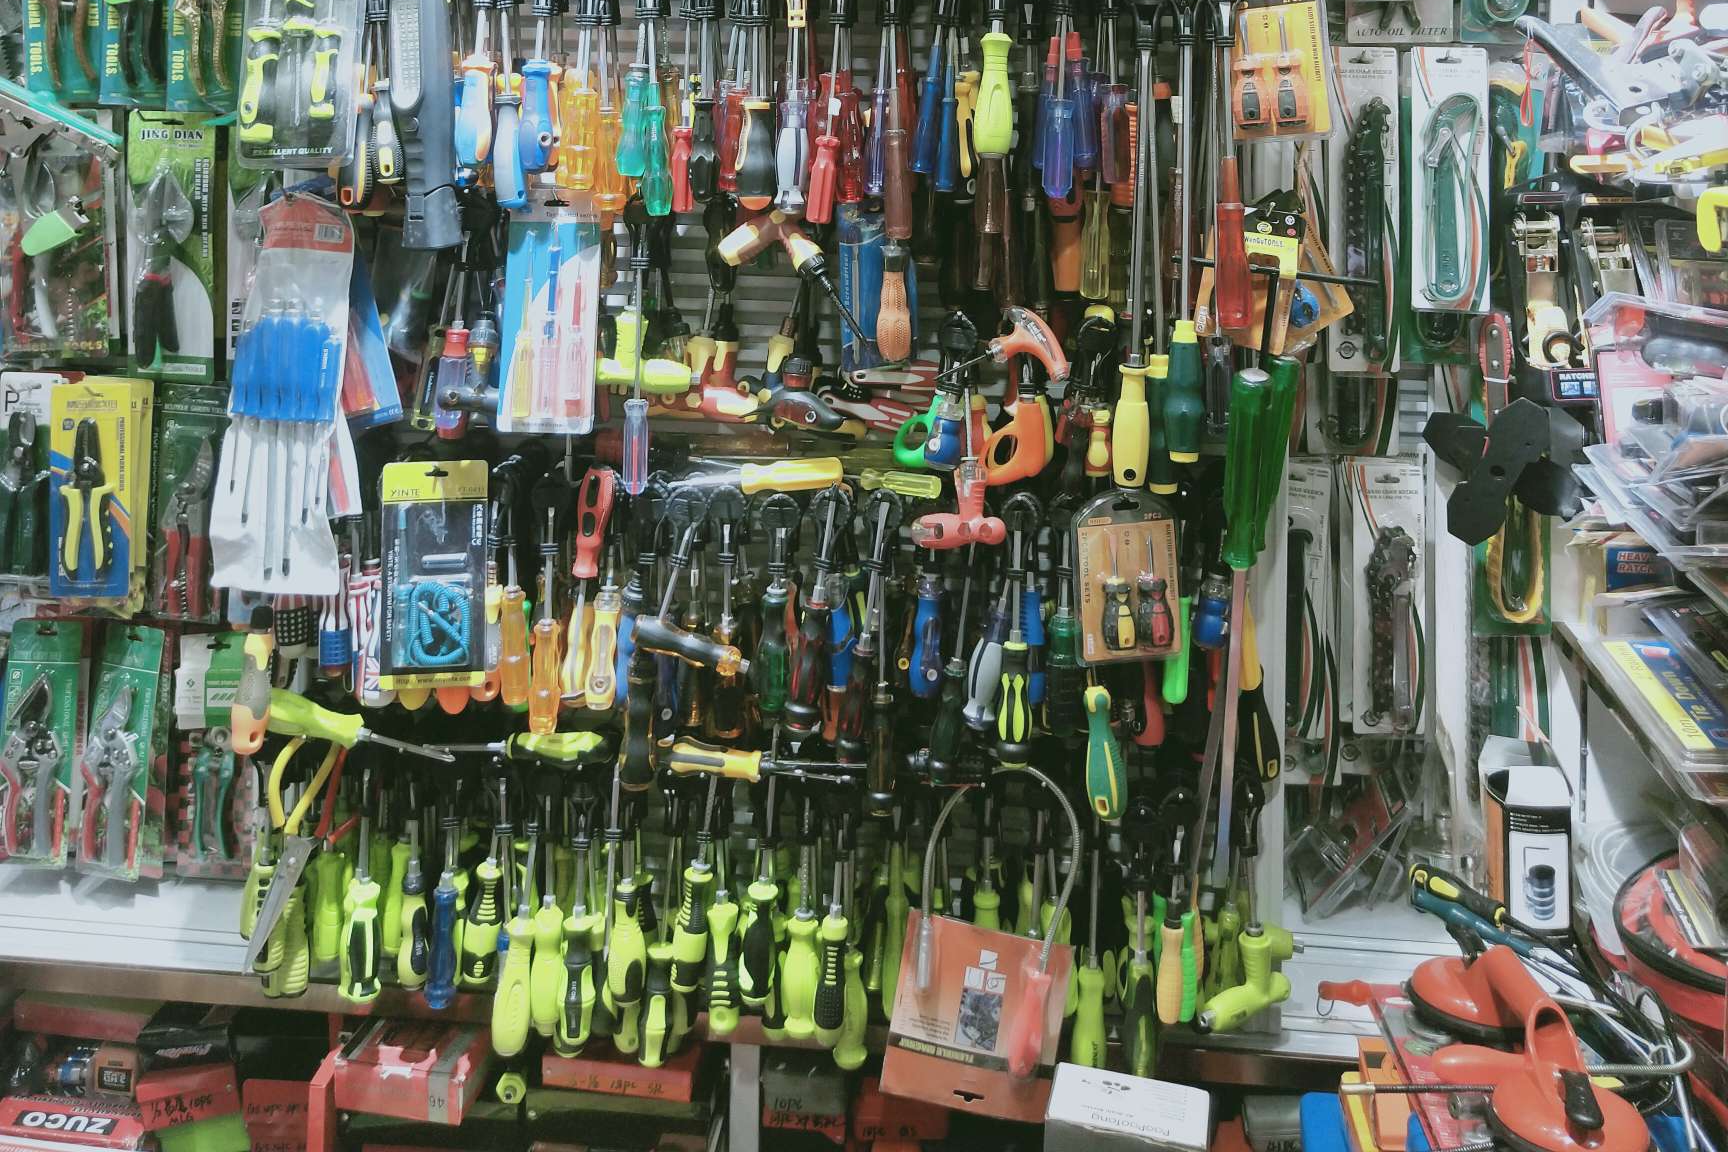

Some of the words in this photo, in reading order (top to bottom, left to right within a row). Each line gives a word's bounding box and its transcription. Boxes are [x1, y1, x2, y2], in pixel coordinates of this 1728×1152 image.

[141, 129, 169, 141] JING
[174, 129, 204, 141] DIAN
[298, 147, 333, 156] QUALITY
[1616, 551, 1650, 562] HEAV
[21, 1110, 114, 1134] ZUCO
